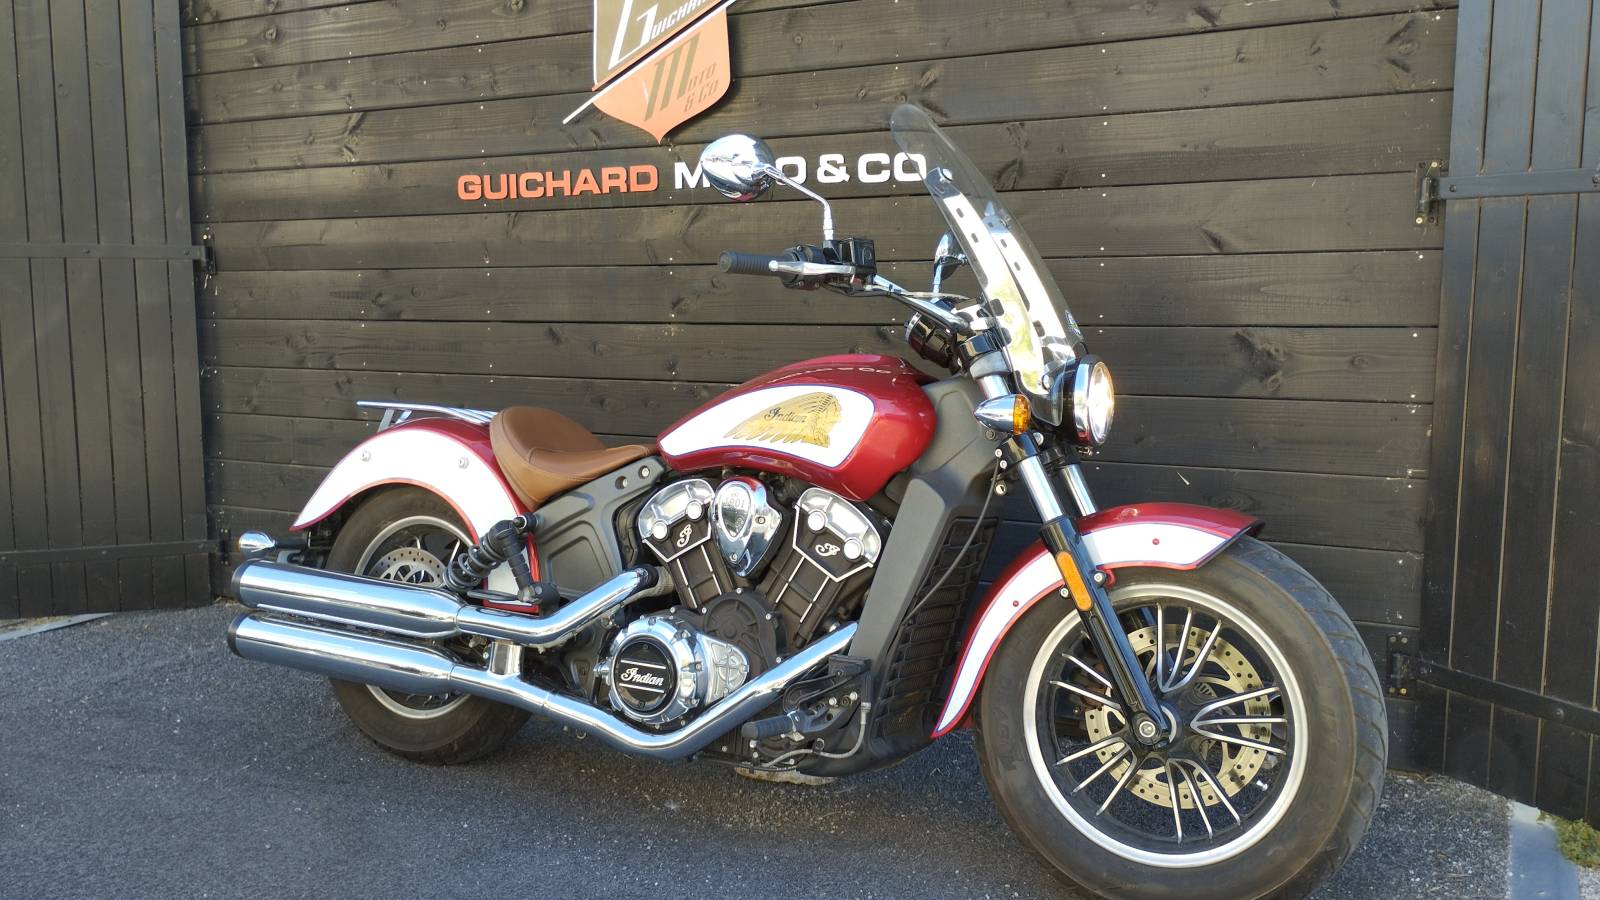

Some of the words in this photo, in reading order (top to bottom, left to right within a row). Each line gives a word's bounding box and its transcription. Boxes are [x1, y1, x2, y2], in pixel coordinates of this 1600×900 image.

[457, 164, 659, 200] GUICHARD
[674, 155, 807, 189] MO
[763, 407, 808, 423] Indian
[620, 667, 665, 687] Indian
